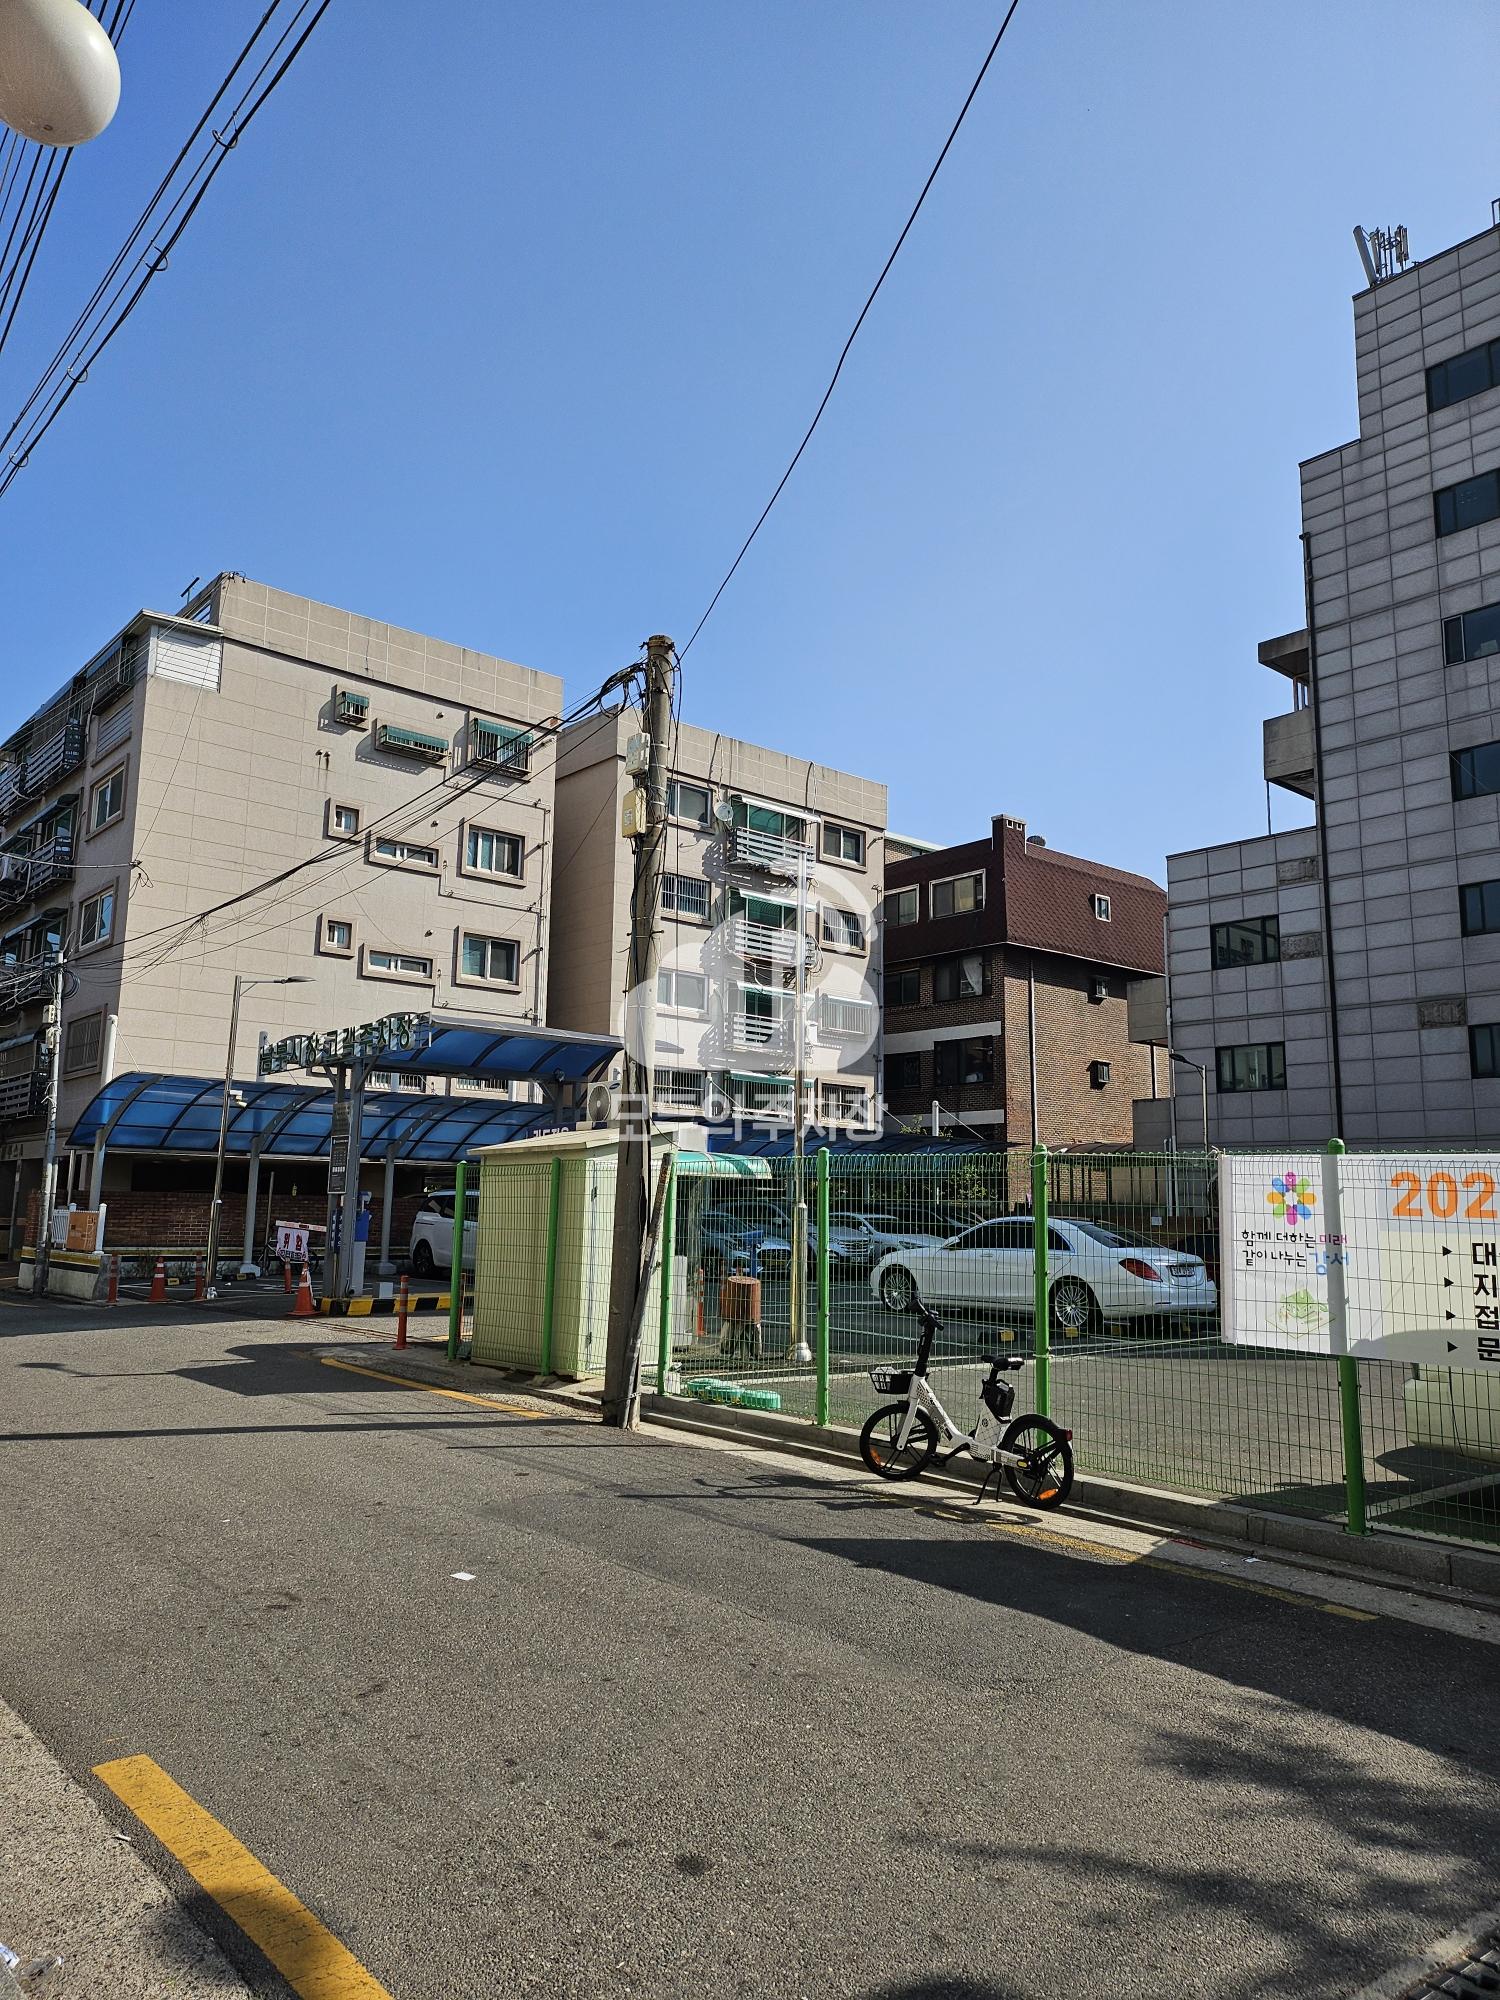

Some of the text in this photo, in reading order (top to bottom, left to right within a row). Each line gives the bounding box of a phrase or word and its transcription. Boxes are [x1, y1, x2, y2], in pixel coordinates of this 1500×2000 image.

[1391, 1171, 1499, 1219] 202
[1241, 1230, 1348, 1249] 함께 더하는 미래
[1242, 1248, 1350, 1276] 같이 나누는 강서
[1474, 1273, 1497, 1299] 지
